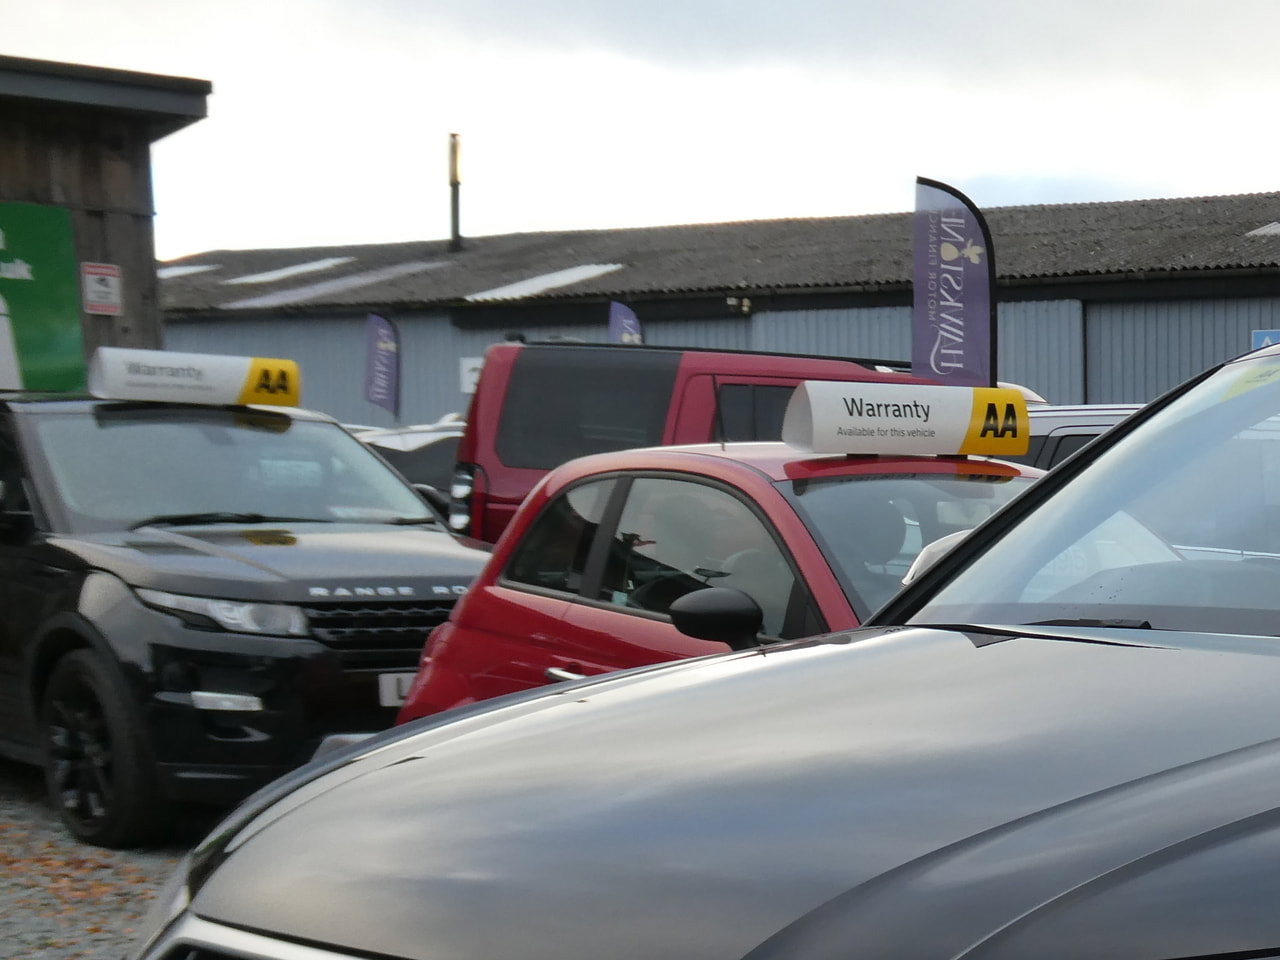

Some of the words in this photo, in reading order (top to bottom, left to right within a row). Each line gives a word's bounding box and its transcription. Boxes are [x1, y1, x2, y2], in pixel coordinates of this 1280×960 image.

[256, 368, 289, 394] AA
[843, 397, 930, 422] Warranty
[980, 403, 1017, 437] AA
[837, 427, 875, 436] Available
[877, 427, 888, 436] for
[890, 427, 905, 436] this
[907, 428, 936, 437] vehicle
[308, 586, 415, 596] RANGE
